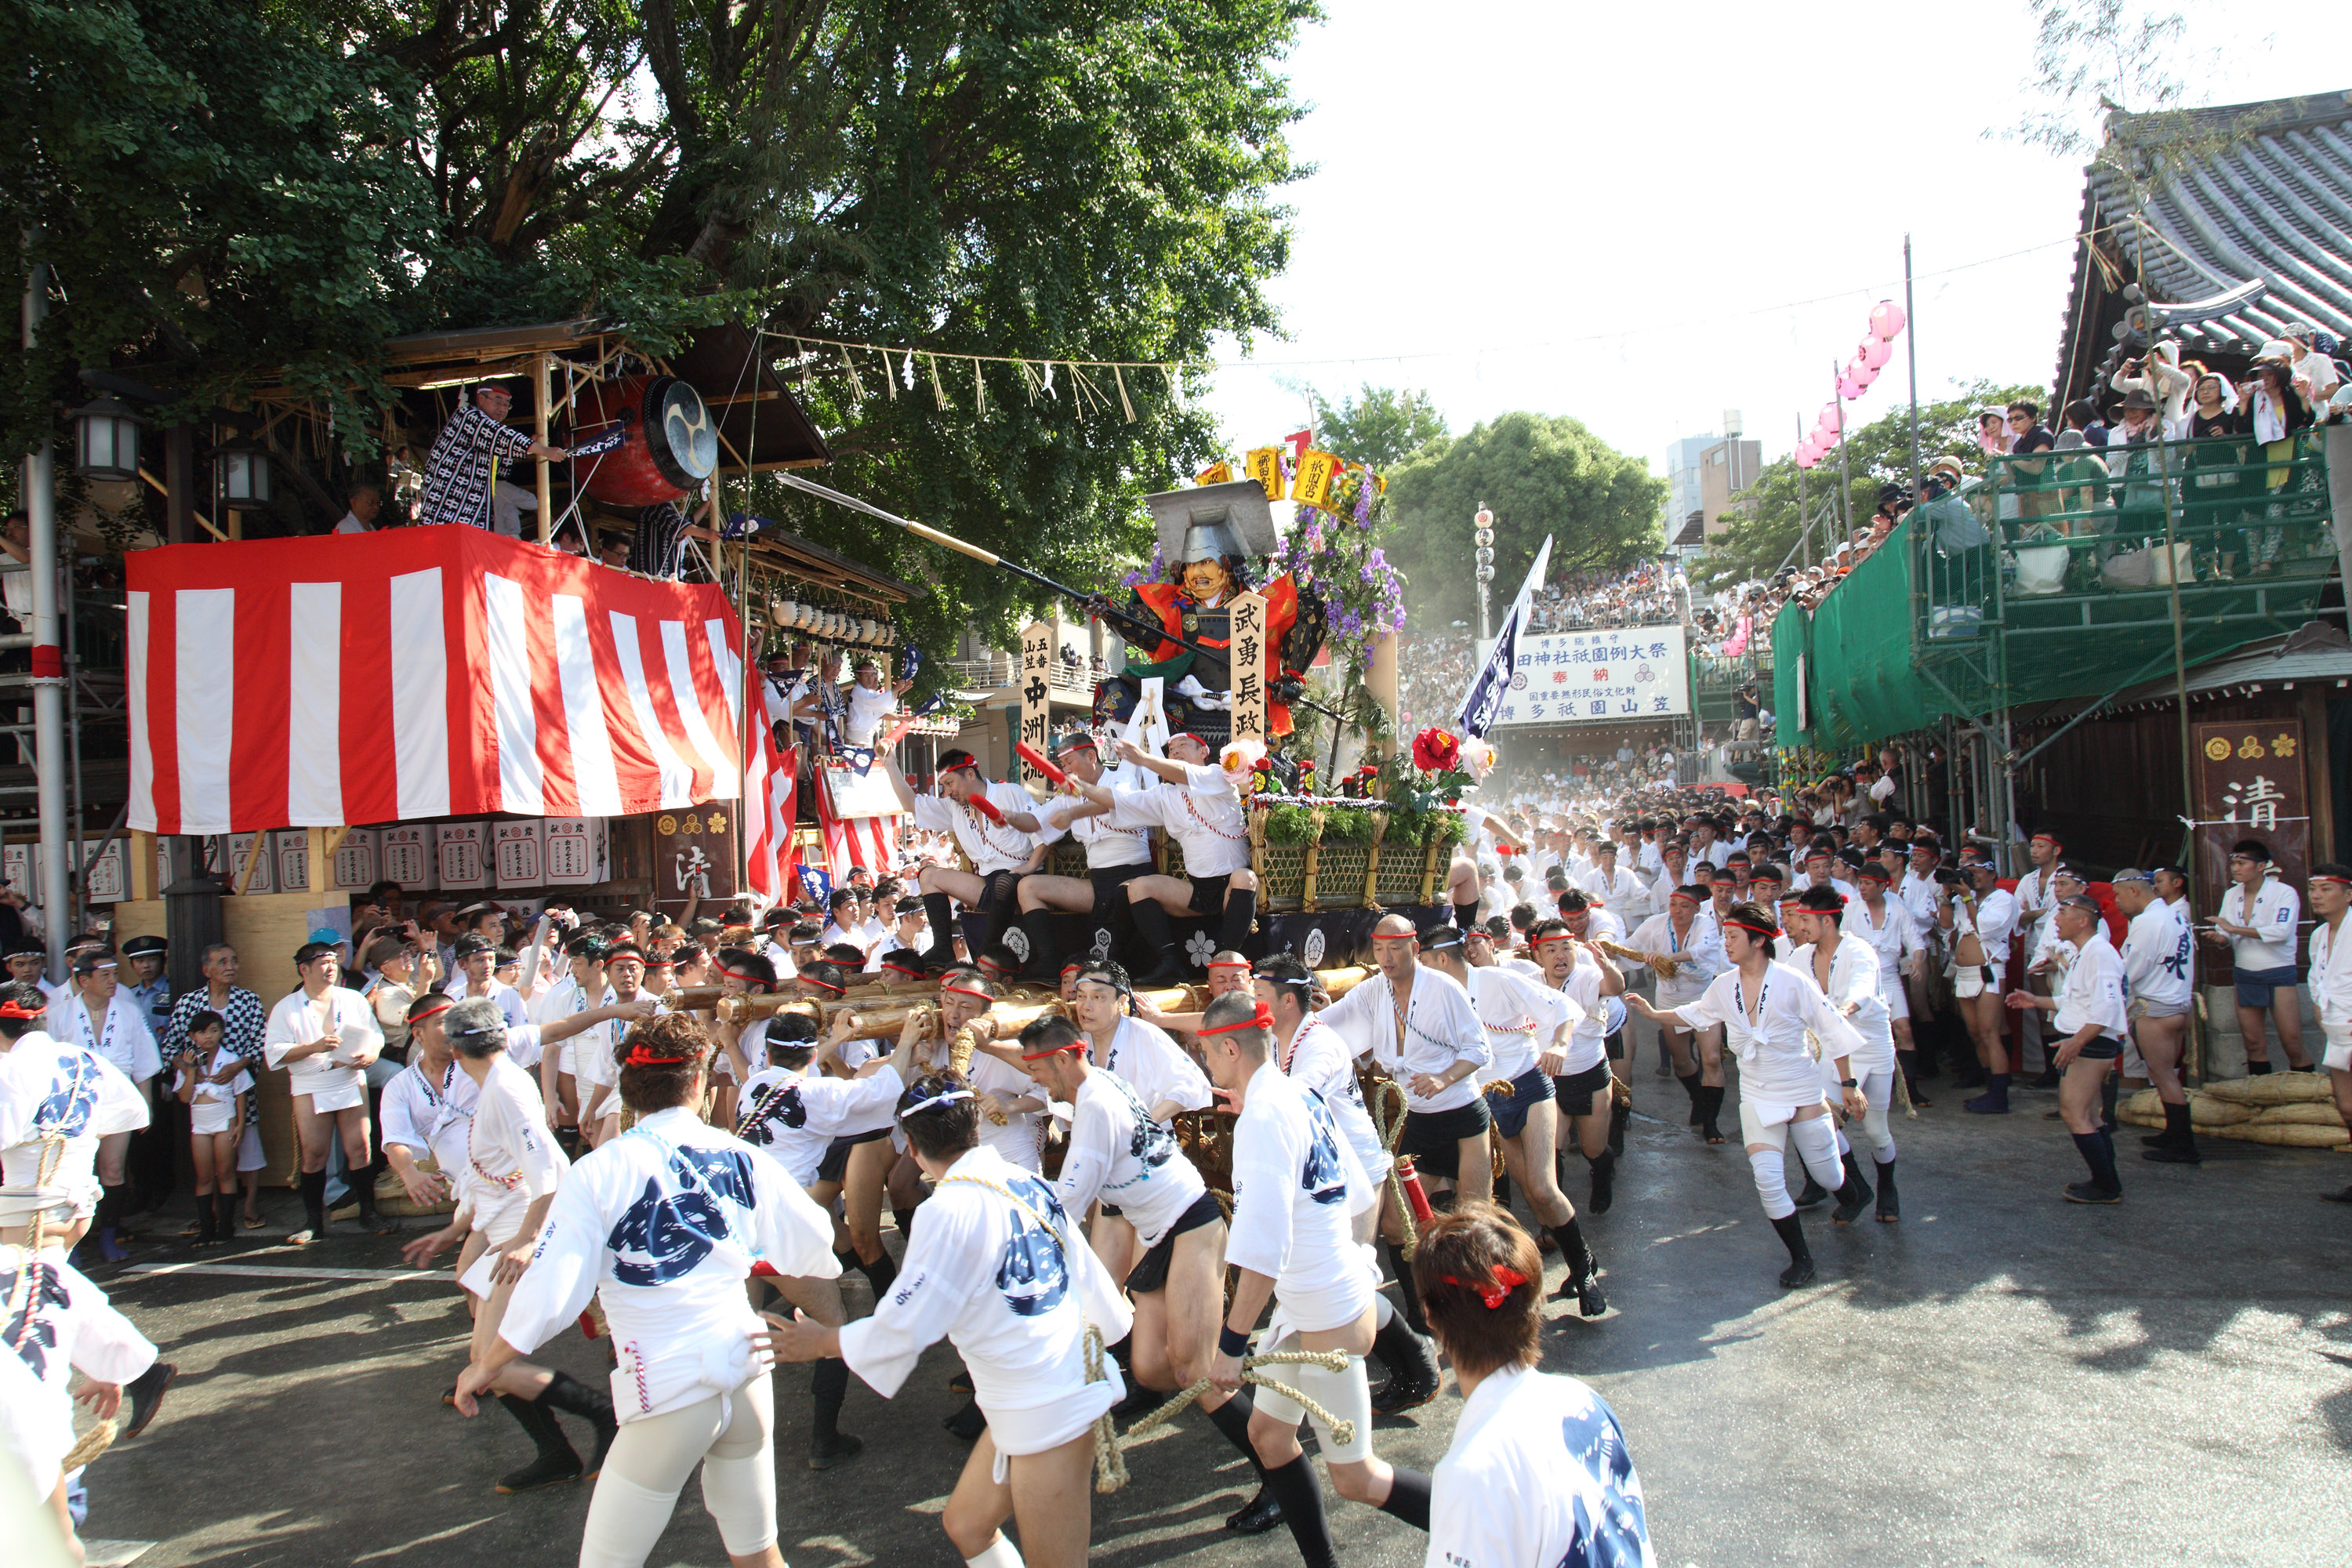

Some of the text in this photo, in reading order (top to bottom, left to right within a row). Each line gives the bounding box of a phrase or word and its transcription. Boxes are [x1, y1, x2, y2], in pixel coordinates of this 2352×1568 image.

[1025, 641, 1036, 670] 山笠
[1036, 638, 1047, 669] 五番
[1235, 603, 1261, 736] 武勇長政
[1552, 667, 1609, 684] 奉納
[1499, 696, 1671, 720] 博多祇園山笠
[1530, 686, 1636, 701] 国重要無形民俗文化財
[514, 843, 523, 877] おたふくわた
[676, 846, 711, 898] 清
